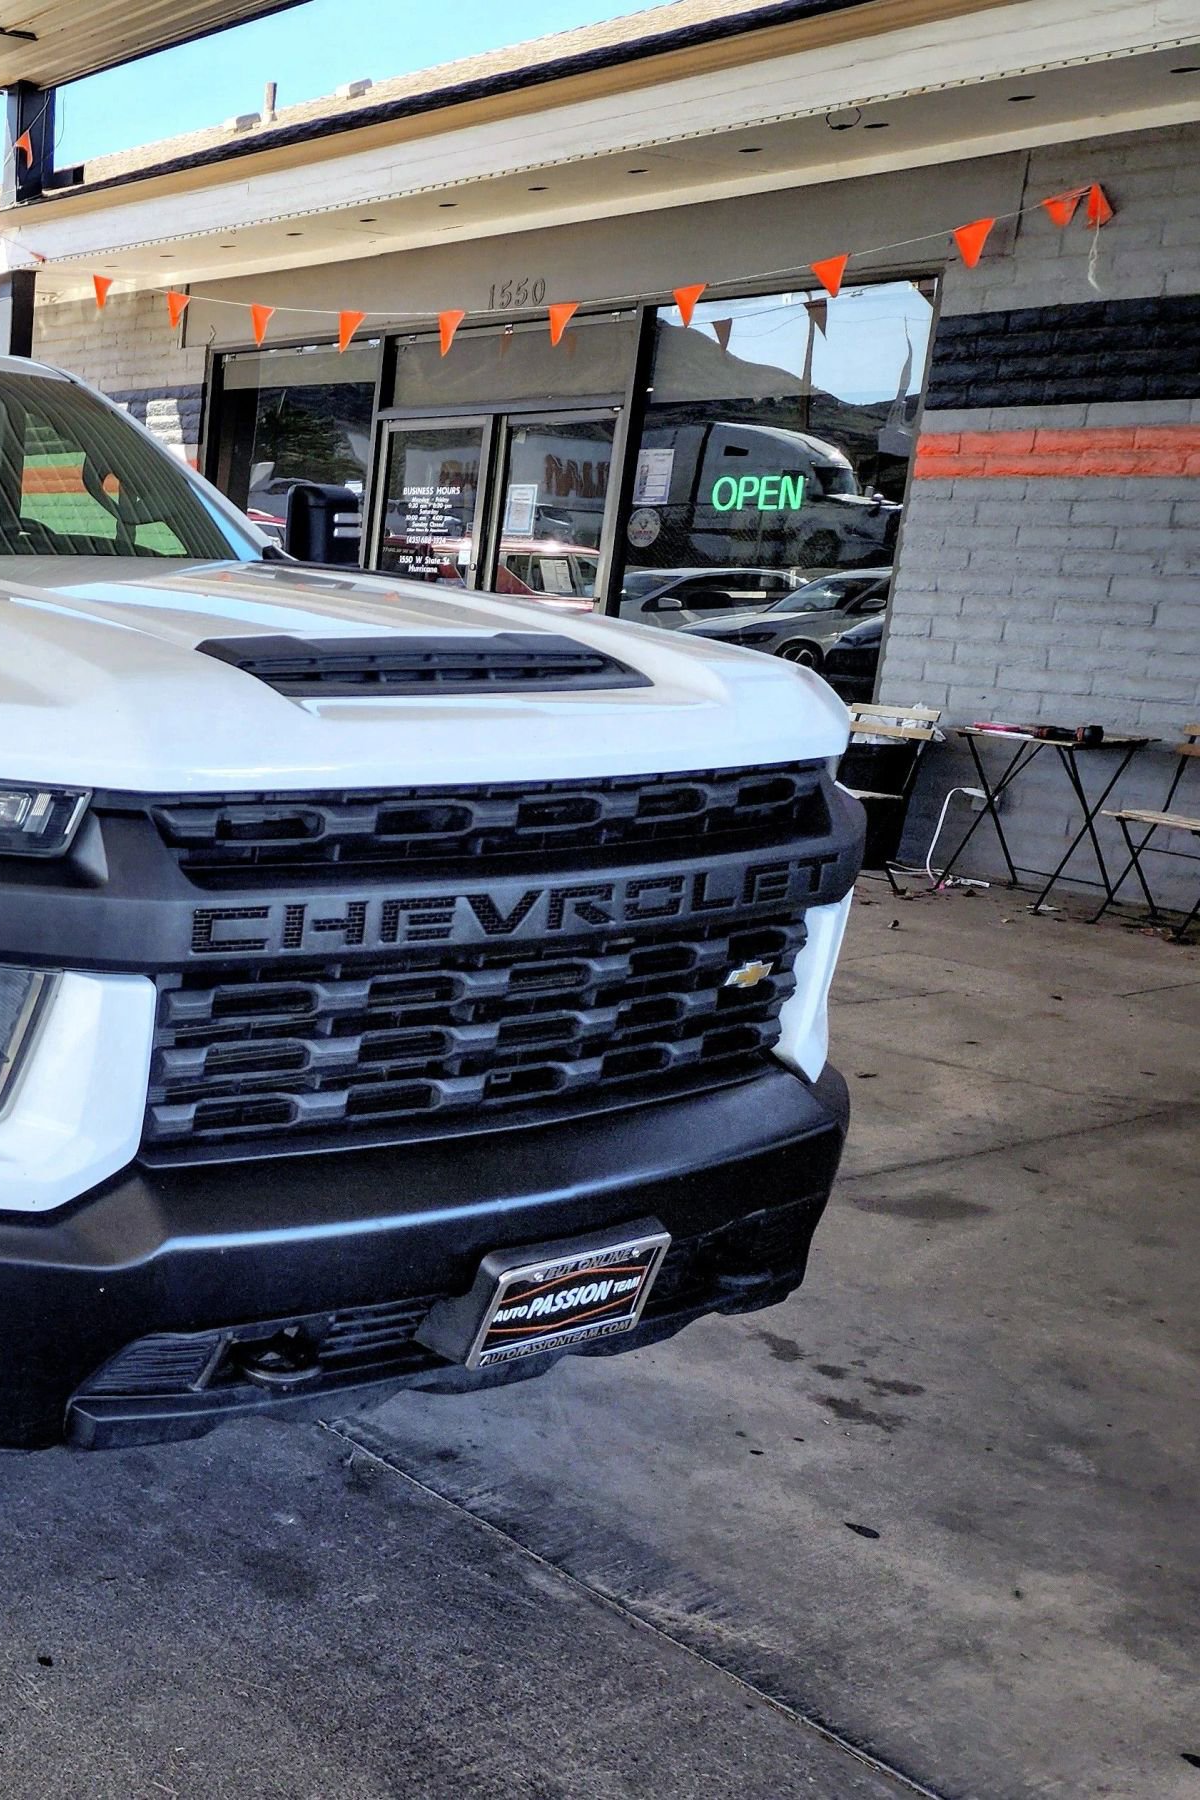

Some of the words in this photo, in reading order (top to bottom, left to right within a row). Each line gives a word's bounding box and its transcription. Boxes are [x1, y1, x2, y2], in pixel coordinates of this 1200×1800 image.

[488, 277, 546, 310] 1550
[402, 486, 434, 495] BUSINESS
[436, 486, 461, 495] HOURS
[712, 475, 804, 511] OPEN
[411, 521, 429, 529] Sunday
[419, 508, 440, 516] Saturday
[407, 564, 438, 573] Hurricane
[415, 555, 423, 564] W
[424, 556, 441, 565] State
[191, 853, 841, 954] CHEVROLET
[545, 1260, 578, 1279] BUY
[578, 1249, 634, 1271] ONLINE
[493, 1304, 529, 1323] AUTO
[526, 1279, 614, 1320] PASSION
[611, 1275, 642, 1295] TEAM
[480, 1320, 630, 1367] AUTOPASSIONTEAM.COM
